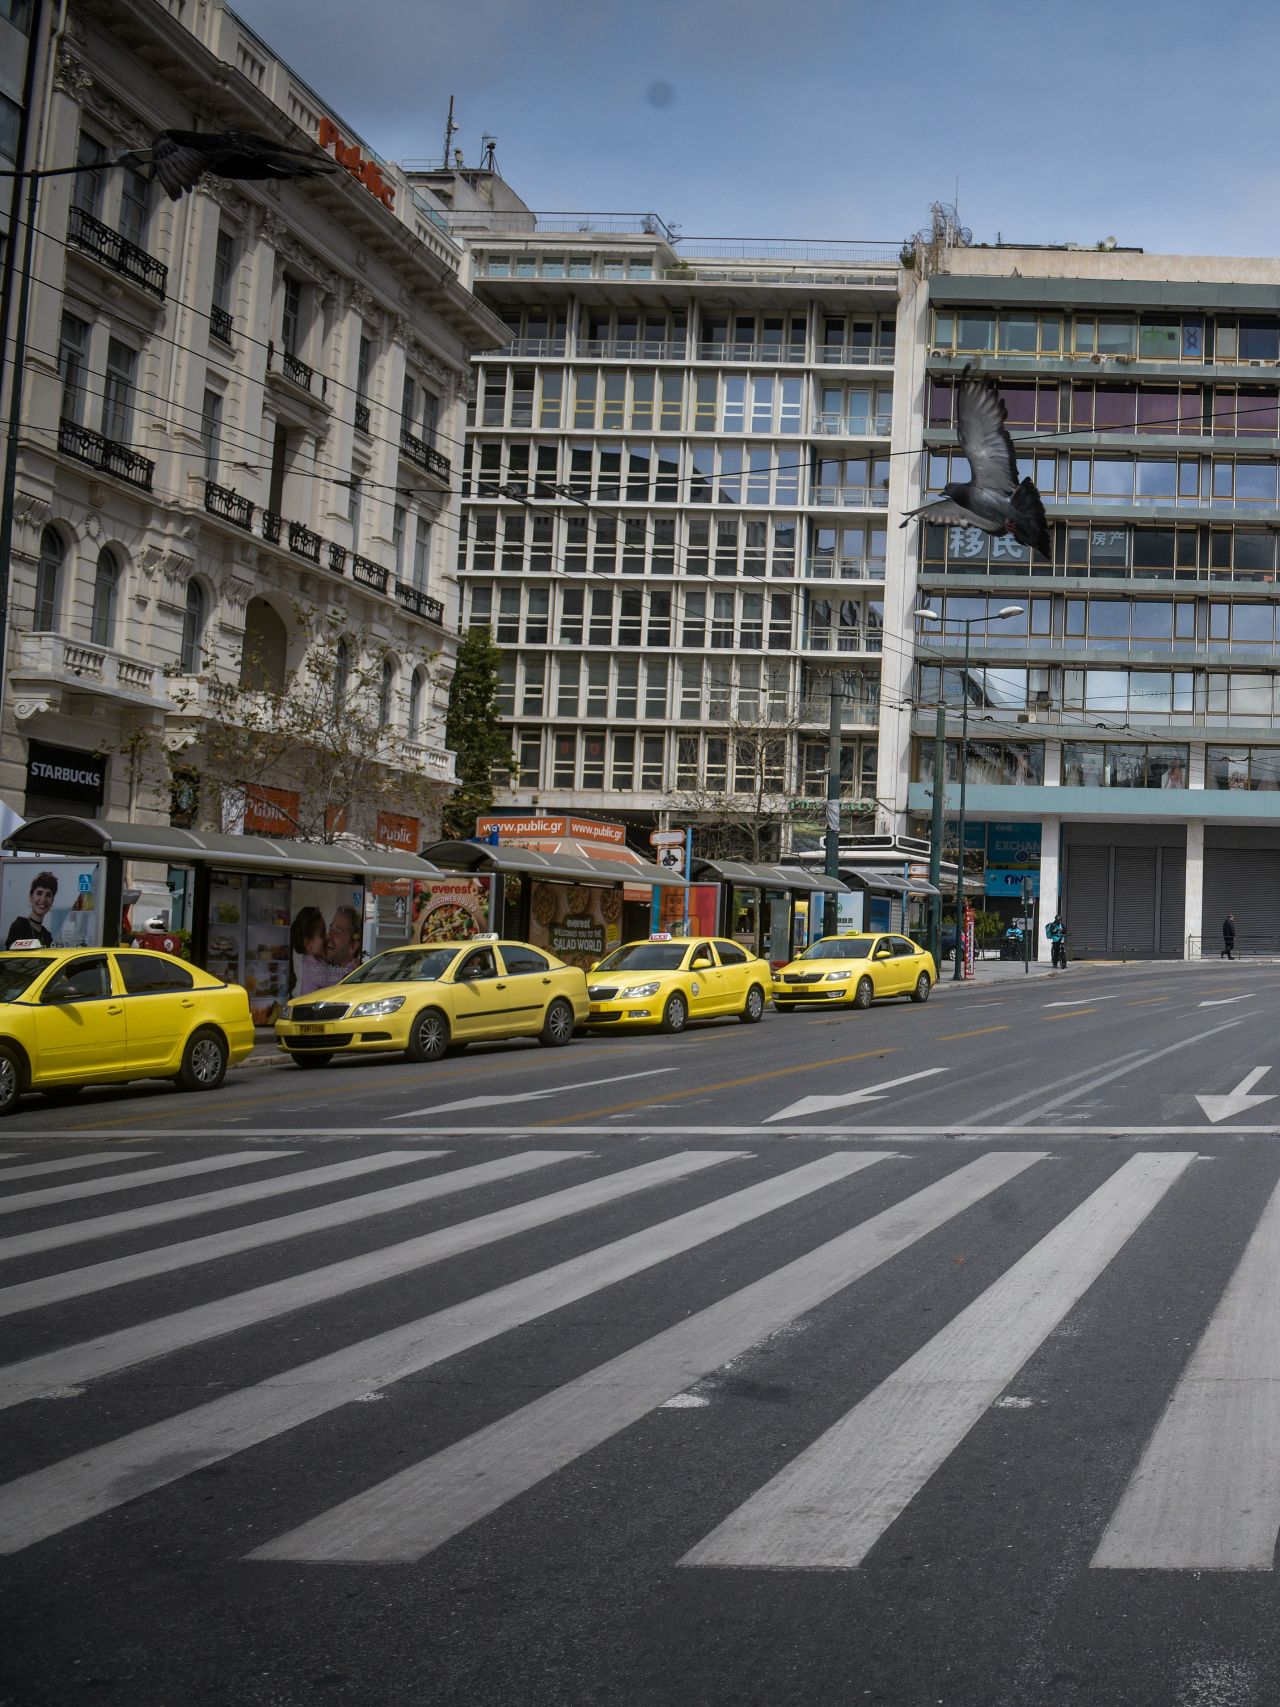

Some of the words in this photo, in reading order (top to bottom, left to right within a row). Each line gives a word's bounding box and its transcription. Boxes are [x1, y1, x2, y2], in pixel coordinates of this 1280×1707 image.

[320, 116, 396, 211] Public
[950, 527, 1023, 558] 移民
[1092, 531, 1125, 546] 房产
[31, 761, 100, 787] STARBUCKS
[380, 827, 412, 844] Public
[572, 822, 623, 841] www.public.gr
[432, 885, 471, 894] everest
[567, 919, 591, 929] everest
[554, 928, 577, 938] WELCOMES
[578, 930, 587, 938] YOU
[593, 929, 602, 938] THE
[554, 938, 576, 950] SALAD
[577, 939, 602, 953] WORLD
